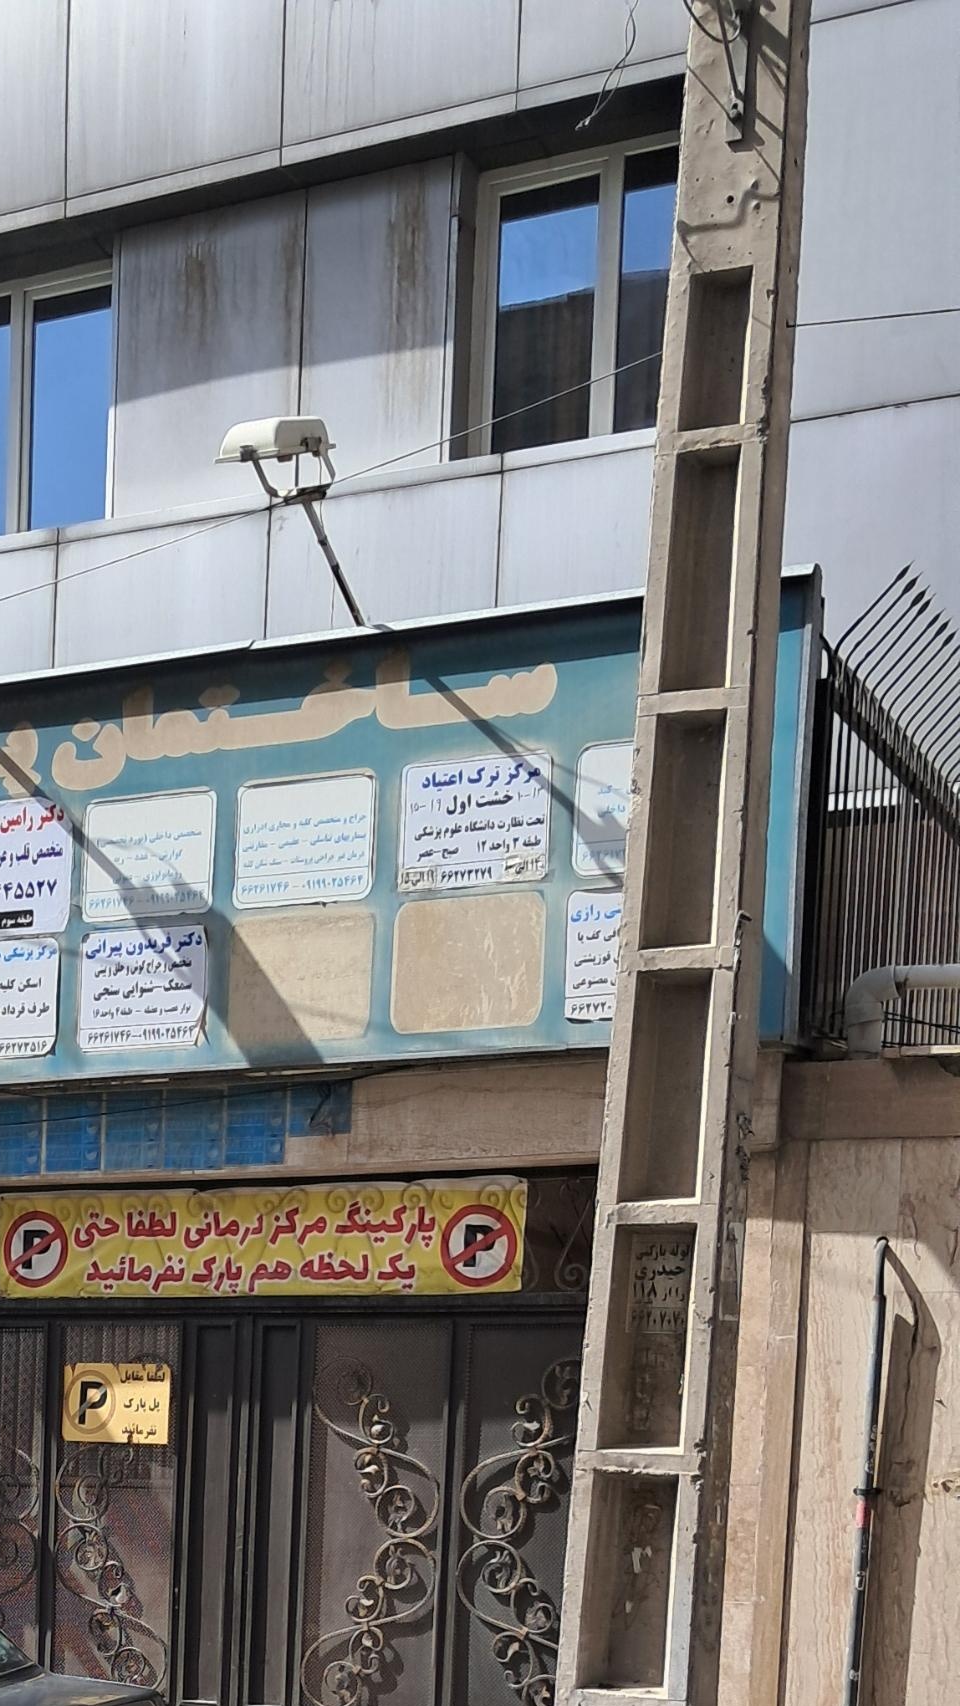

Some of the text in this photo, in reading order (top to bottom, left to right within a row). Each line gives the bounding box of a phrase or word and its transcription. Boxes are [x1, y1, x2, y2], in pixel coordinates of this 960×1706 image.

[51, 658, 558, 790] ساختمان
[422, 763, 541, 792] مرکز ترک اعتیاد
[447, 790, 513, 815] خشت اول
[0, 806, 33, 833] رامین
[37, 804, 64, 830] دکتر
[414, 814, 545, 841] تحت نظارت دانشگاه علوم پزشکی
[489, 840, 510, 853] واحد
[522, 835, 541, 849] طبقه
[16, 843, 30, 865] قلب
[32, 841, 63, 864] متخصص
[17, 914, 32, 925] طبقه
[571, 904, 599, 922] رازی
[1, 917, 15, 926] سوم
[37, 944, 57, 960] مرکز
[85, 932, 202, 959] دکتر فریدون پیرانی
[4, 946, 33, 962] پزشکی
[146, 959, 161, 974] جراح
[169, 956, 192, 972] متخصص
[18, 977, 41, 992] اسکن
[94, 986, 120, 1001] سنجی
[28, 1002, 49, 1017] طرف
[74, 1201, 436, 1249] پارکینگ مرکز درمانی لطفا حتی
[670, 1244, 690, 1261] لوله
[86, 1252, 416, 1295] یک لحظه هم پارک نفرمائید
[635, 1265, 686, 1280] حیدری
[120, 1368, 165, 1383] لطفا مقابل
[124, 1398, 160, 1412] پل پارک
